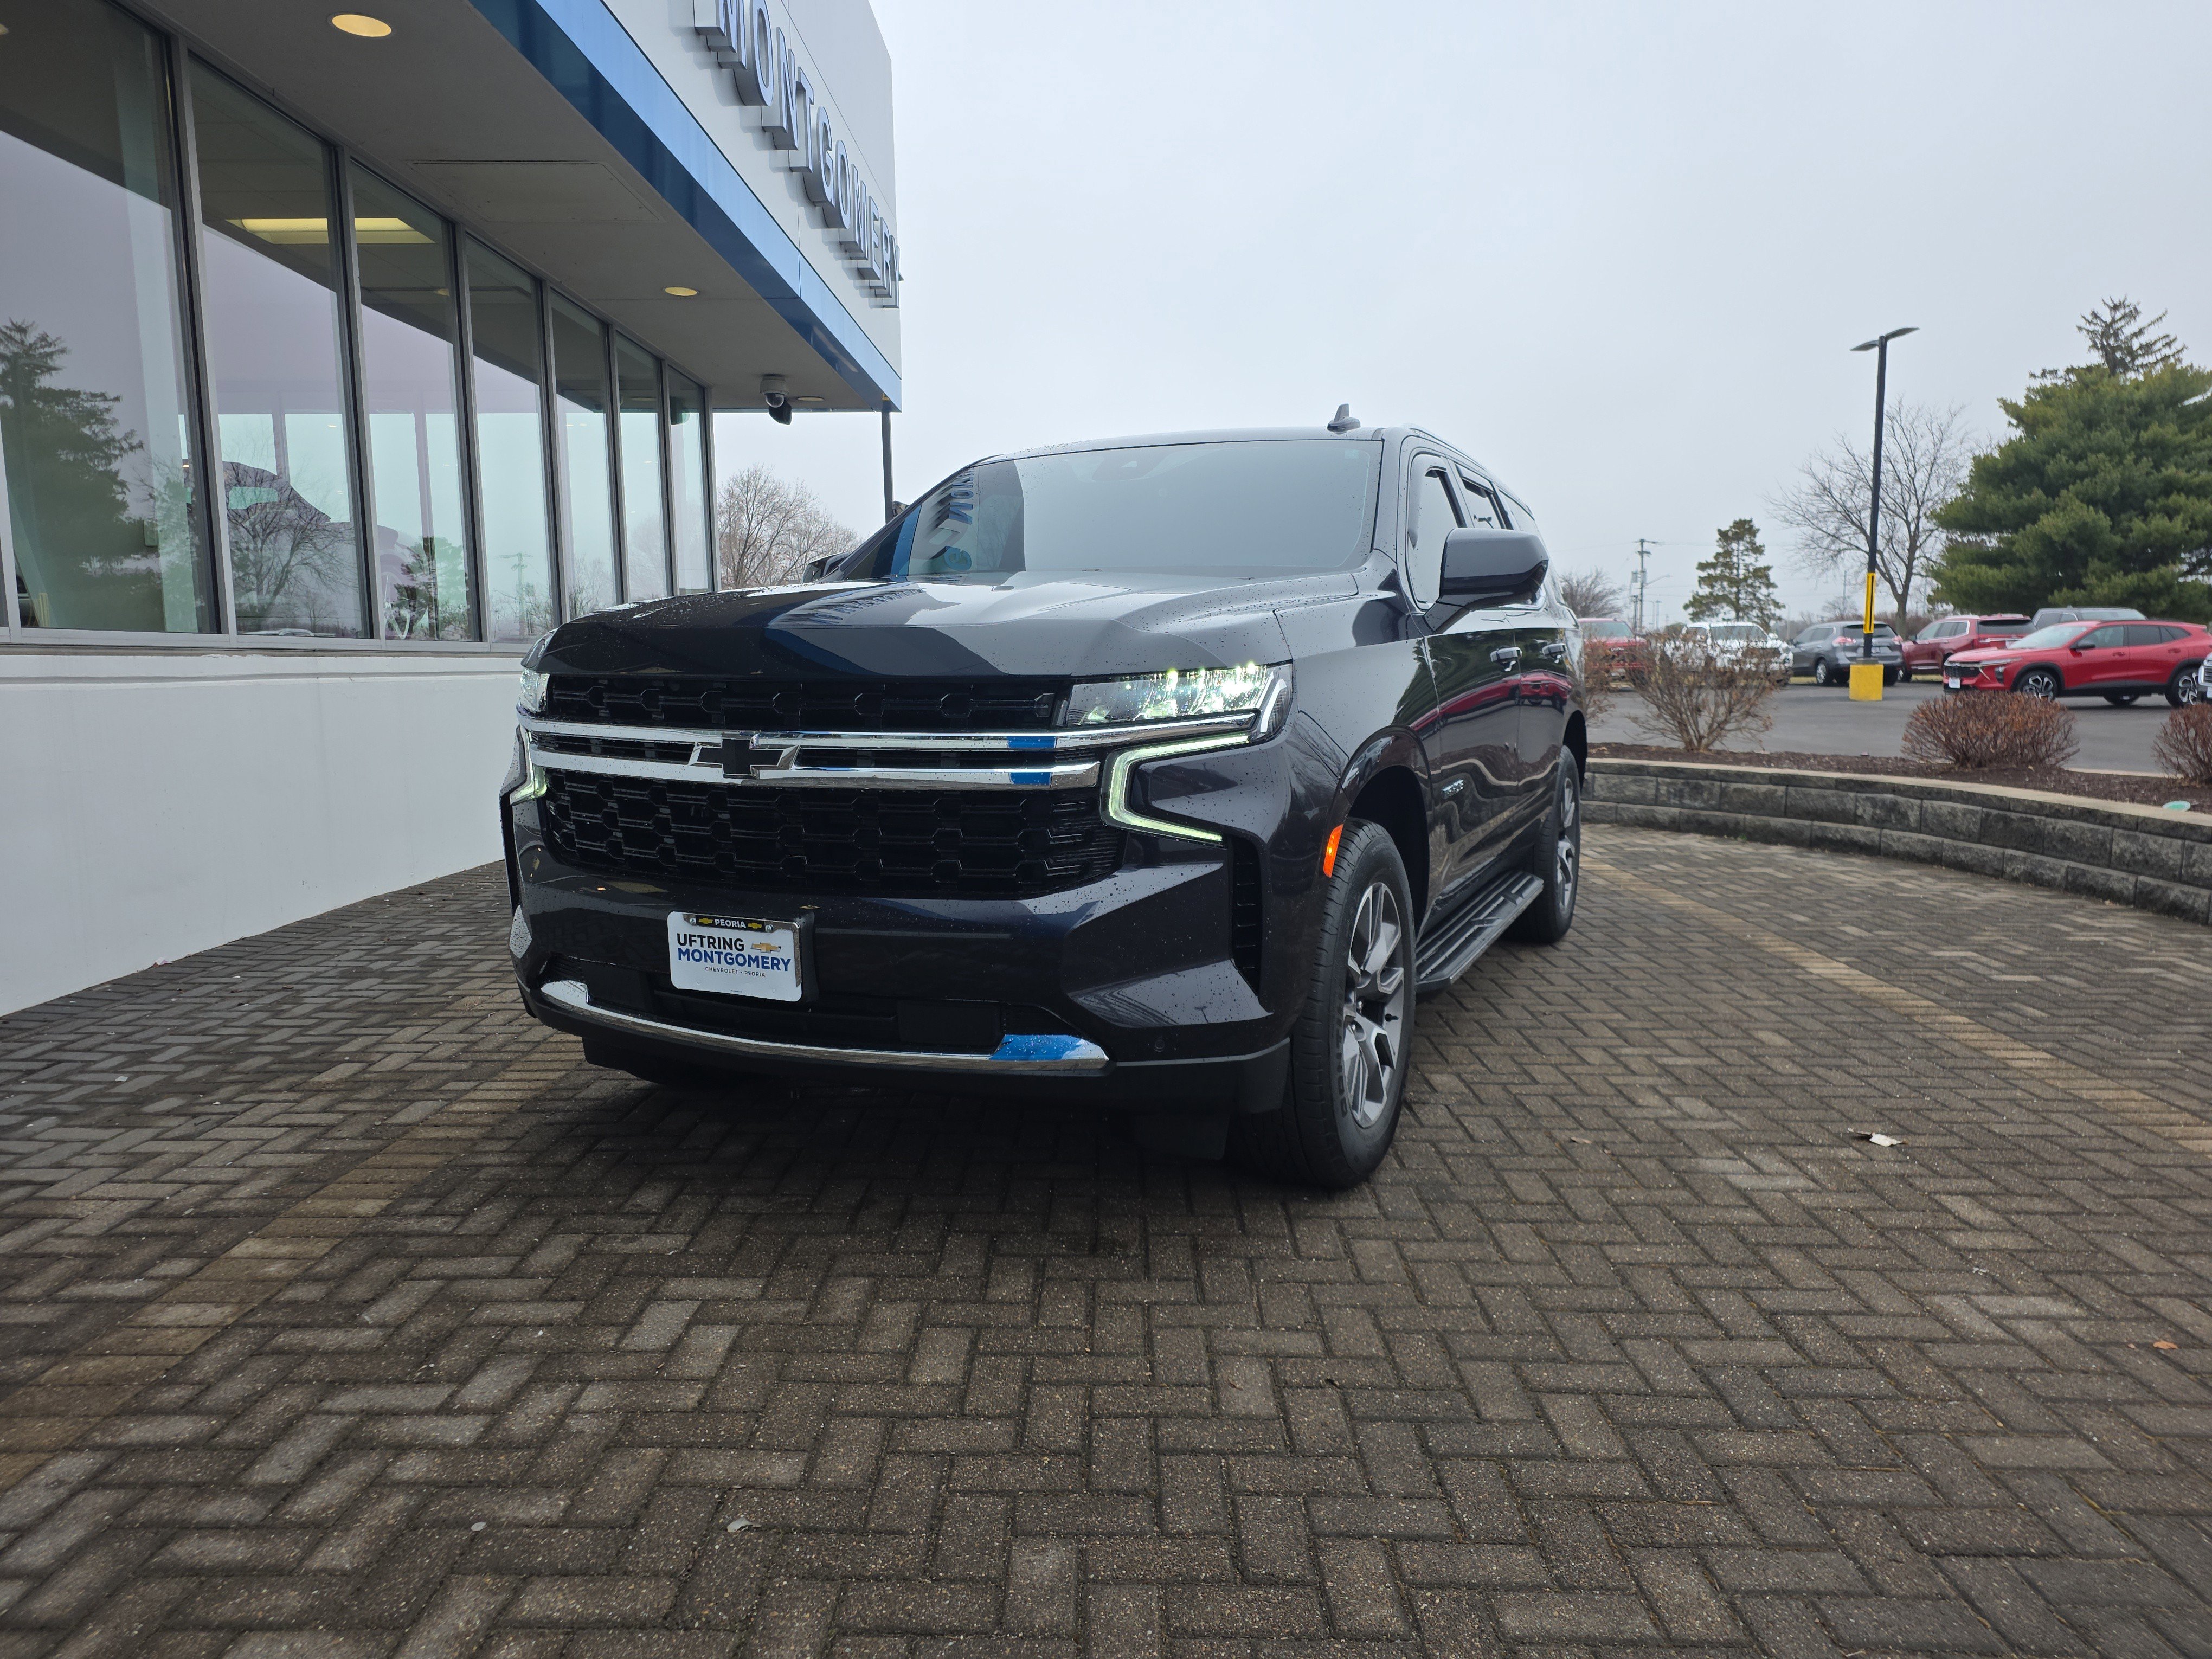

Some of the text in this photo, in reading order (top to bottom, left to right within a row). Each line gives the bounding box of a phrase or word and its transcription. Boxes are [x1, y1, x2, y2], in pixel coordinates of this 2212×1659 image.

[715, 918, 747, 929] PEORIA
[677, 933, 745, 952] UFTRING
[678, 947, 792, 972] MONTGOMERY
[705, 966, 738, 974] CHEVROLET
